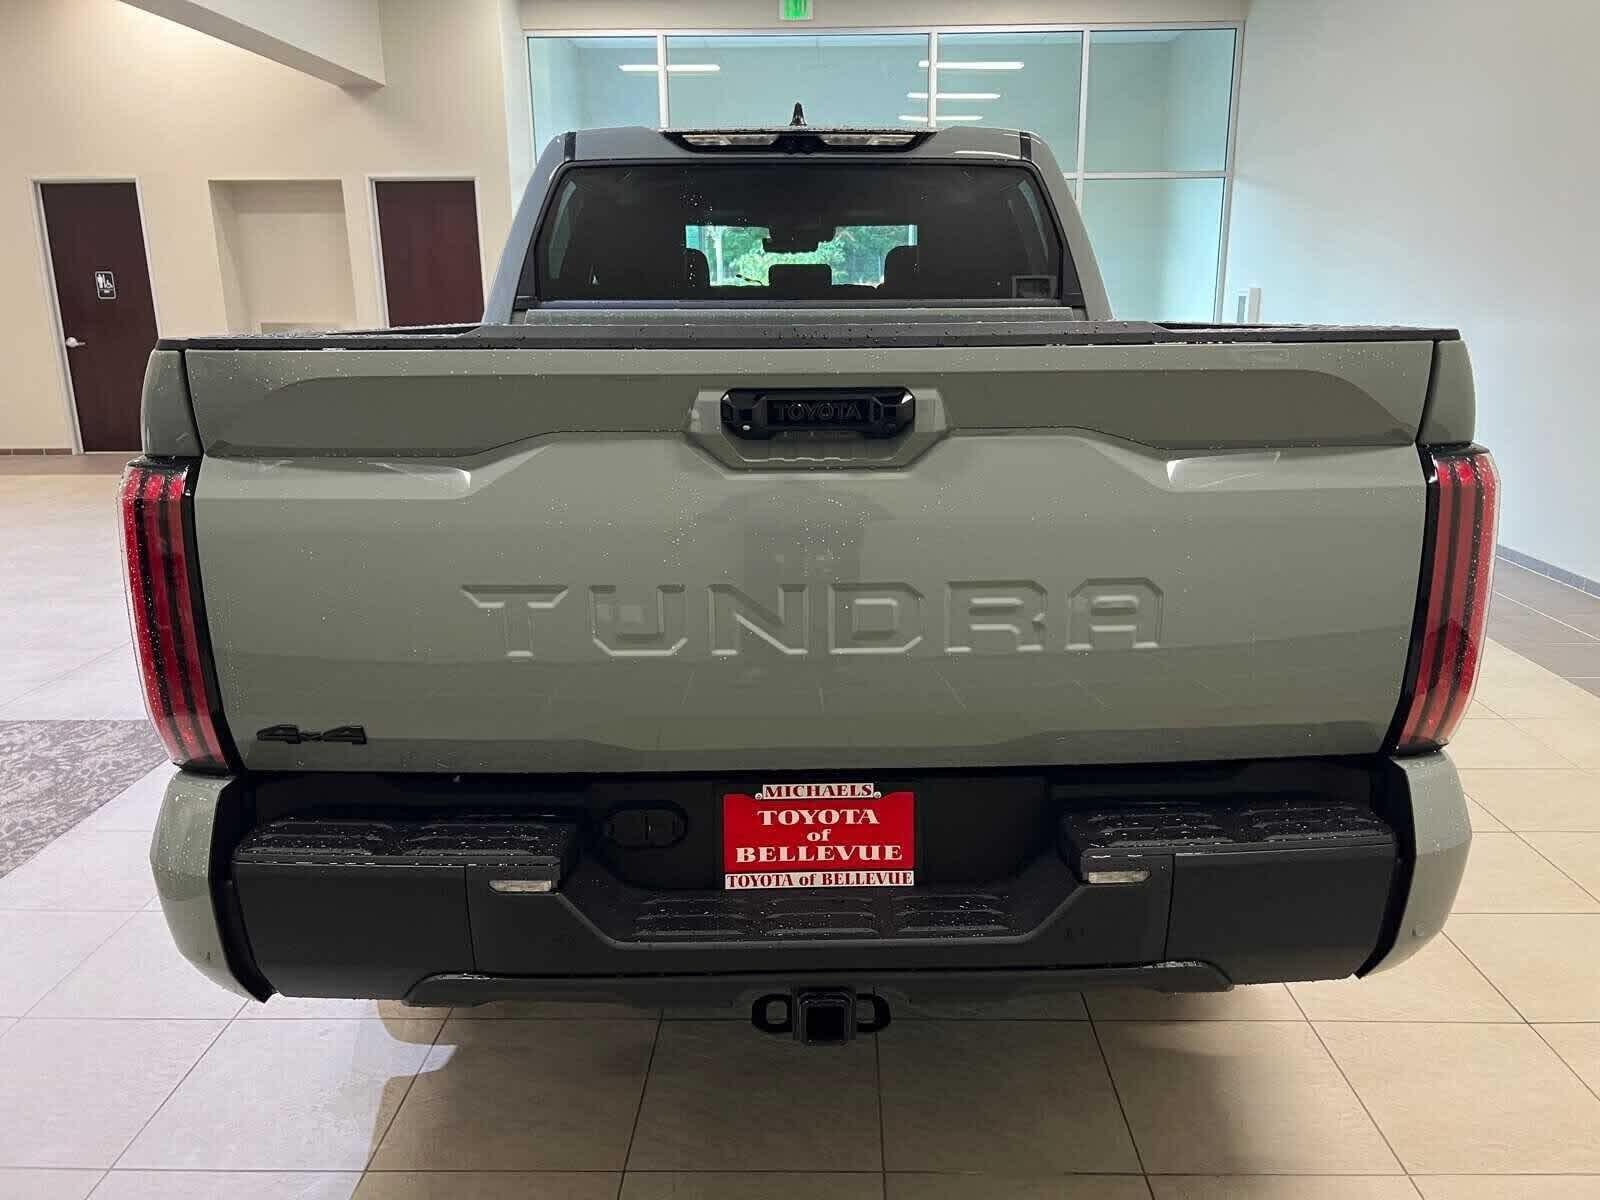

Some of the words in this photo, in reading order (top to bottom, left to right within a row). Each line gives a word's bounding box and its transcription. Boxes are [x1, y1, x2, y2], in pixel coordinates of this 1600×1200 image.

[775, 402, 861, 421] TOYOTA
[460, 577, 1164, 658] TUNDRA
[765, 784, 872, 798] MICHAELS
[757, 809, 880, 826] TOYOTA
[806, 829, 831, 842] of
[735, 845, 902, 863] BELLEVUE
[727, 874, 794, 887] TOYOTA
[798, 873, 817, 886] of
[822, 872, 912, 886] BELLEVUE
